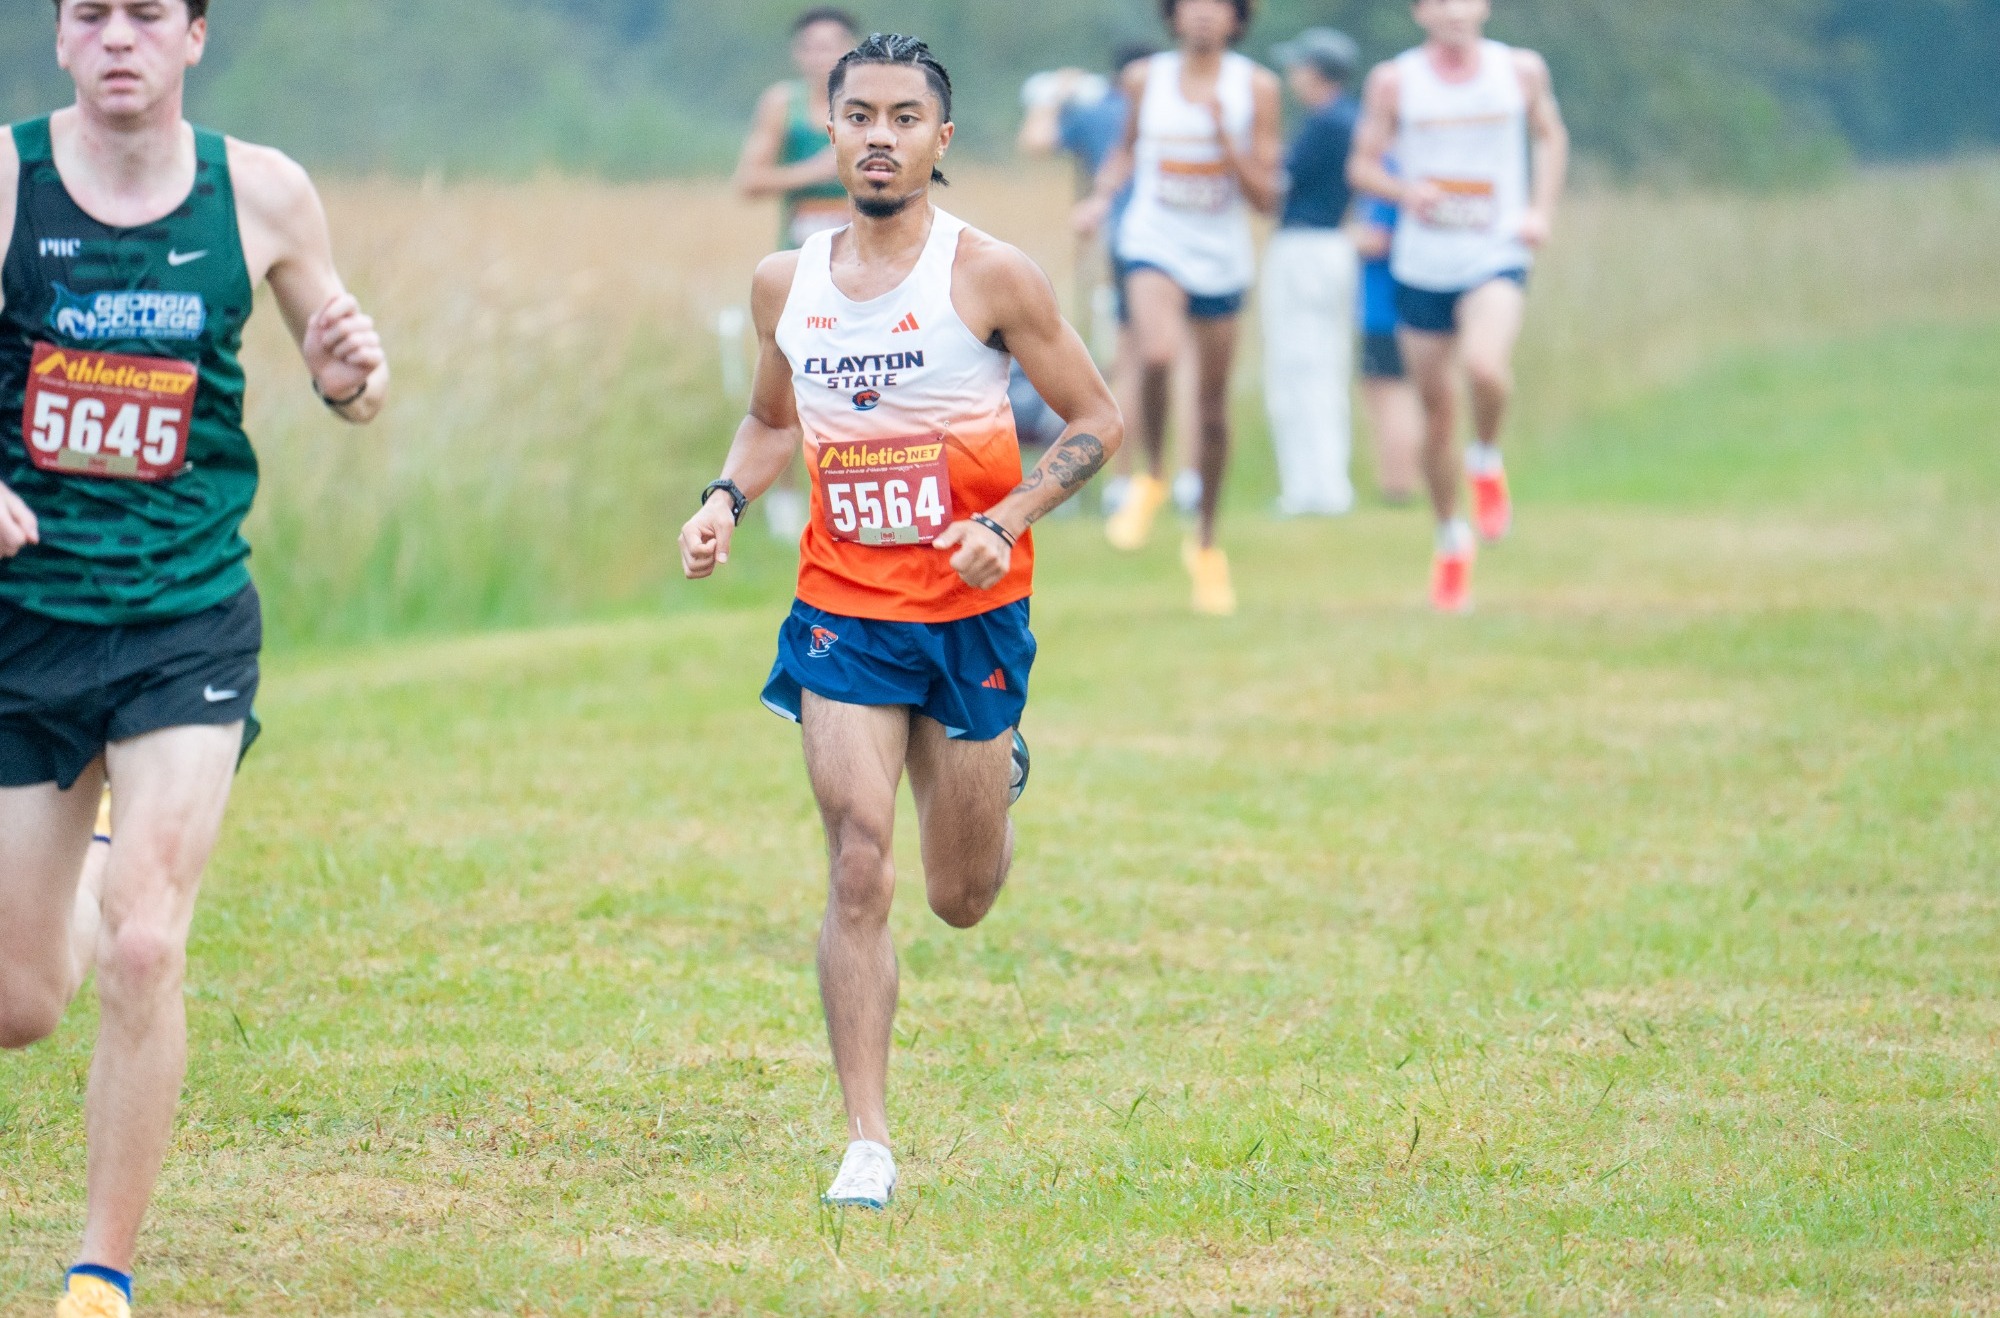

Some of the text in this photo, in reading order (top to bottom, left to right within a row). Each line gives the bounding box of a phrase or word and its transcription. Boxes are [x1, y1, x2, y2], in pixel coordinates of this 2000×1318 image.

[94, 292, 202, 312] GEORGIA
[96, 308, 201, 330] COLLEGE
[806, 316, 838, 330] PBC
[803, 350, 925, 375] CLAYTON
[826, 373, 898, 389] STATE
[31, 390, 182, 466] 5645
[827, 475, 945, 533] 5564
